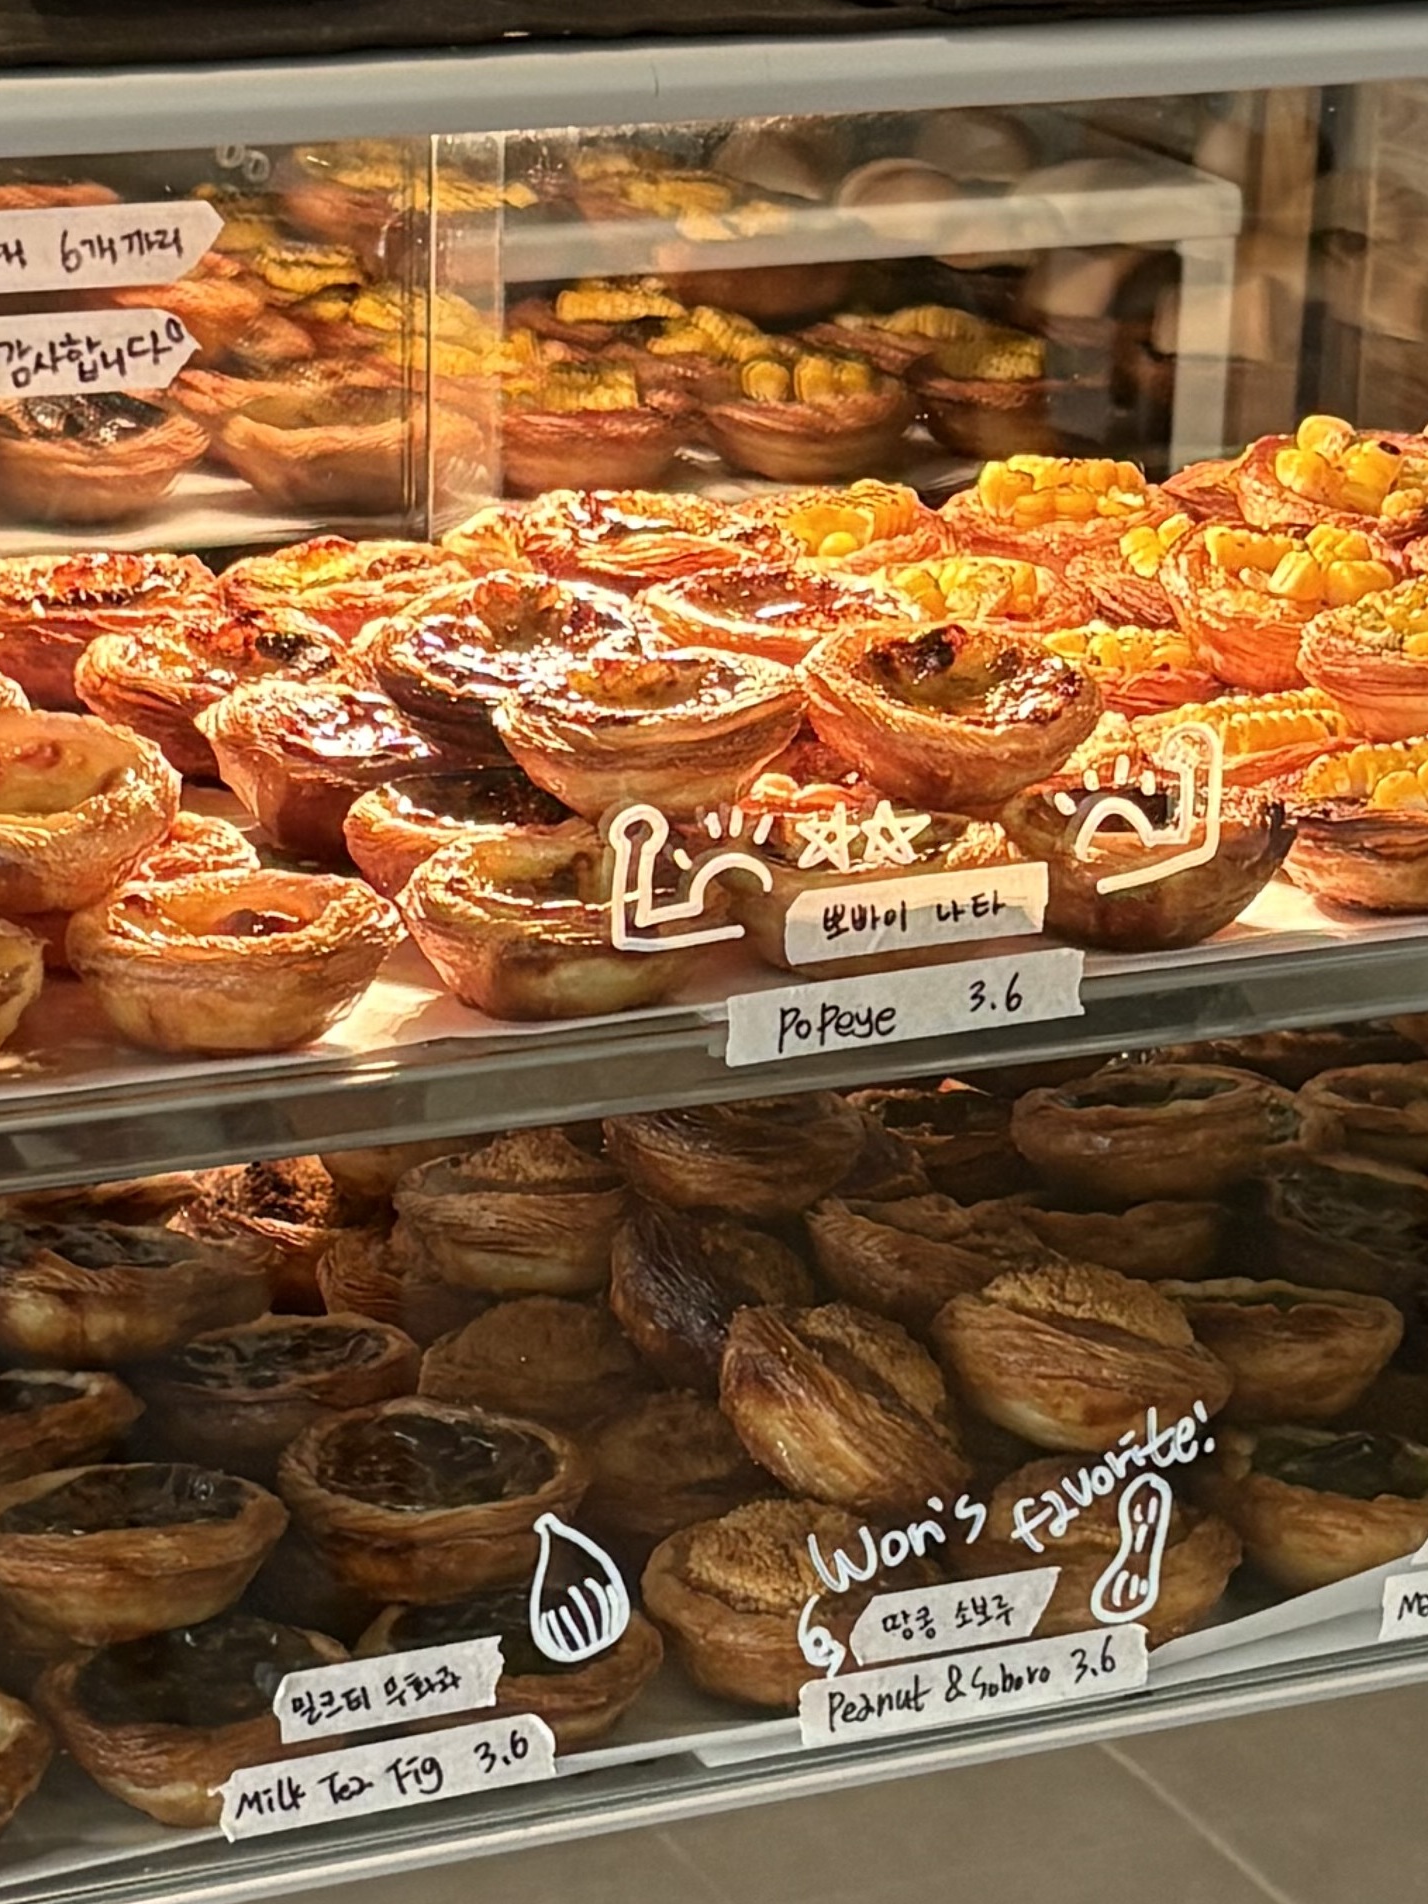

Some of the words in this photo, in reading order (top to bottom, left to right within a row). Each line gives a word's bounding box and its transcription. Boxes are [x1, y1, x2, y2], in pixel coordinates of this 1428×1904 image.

[823, 900, 907, 941] 뽀빠이
[936, 890, 1007, 923] 나타
[968, 972, 1023, 1013] 3.6
[806, 1492, 987, 1594] Won's
[882, 1610, 936, 1640] 땅콩
[954, 1594, 1016, 1630] 소보루
[291, 1685, 370, 1726] 밀크티
[383, 1665, 462, 1707] 무화과
[828, 1674, 932, 1733] Peanut
[1071, 1634, 1118, 1683] 3.6
[235, 1776, 306, 1820] Milk
[317, 1771, 375, 1806] Tea
[385, 1755, 445, 1796] Fig
[473, 1729, 529, 1775] 3.6
